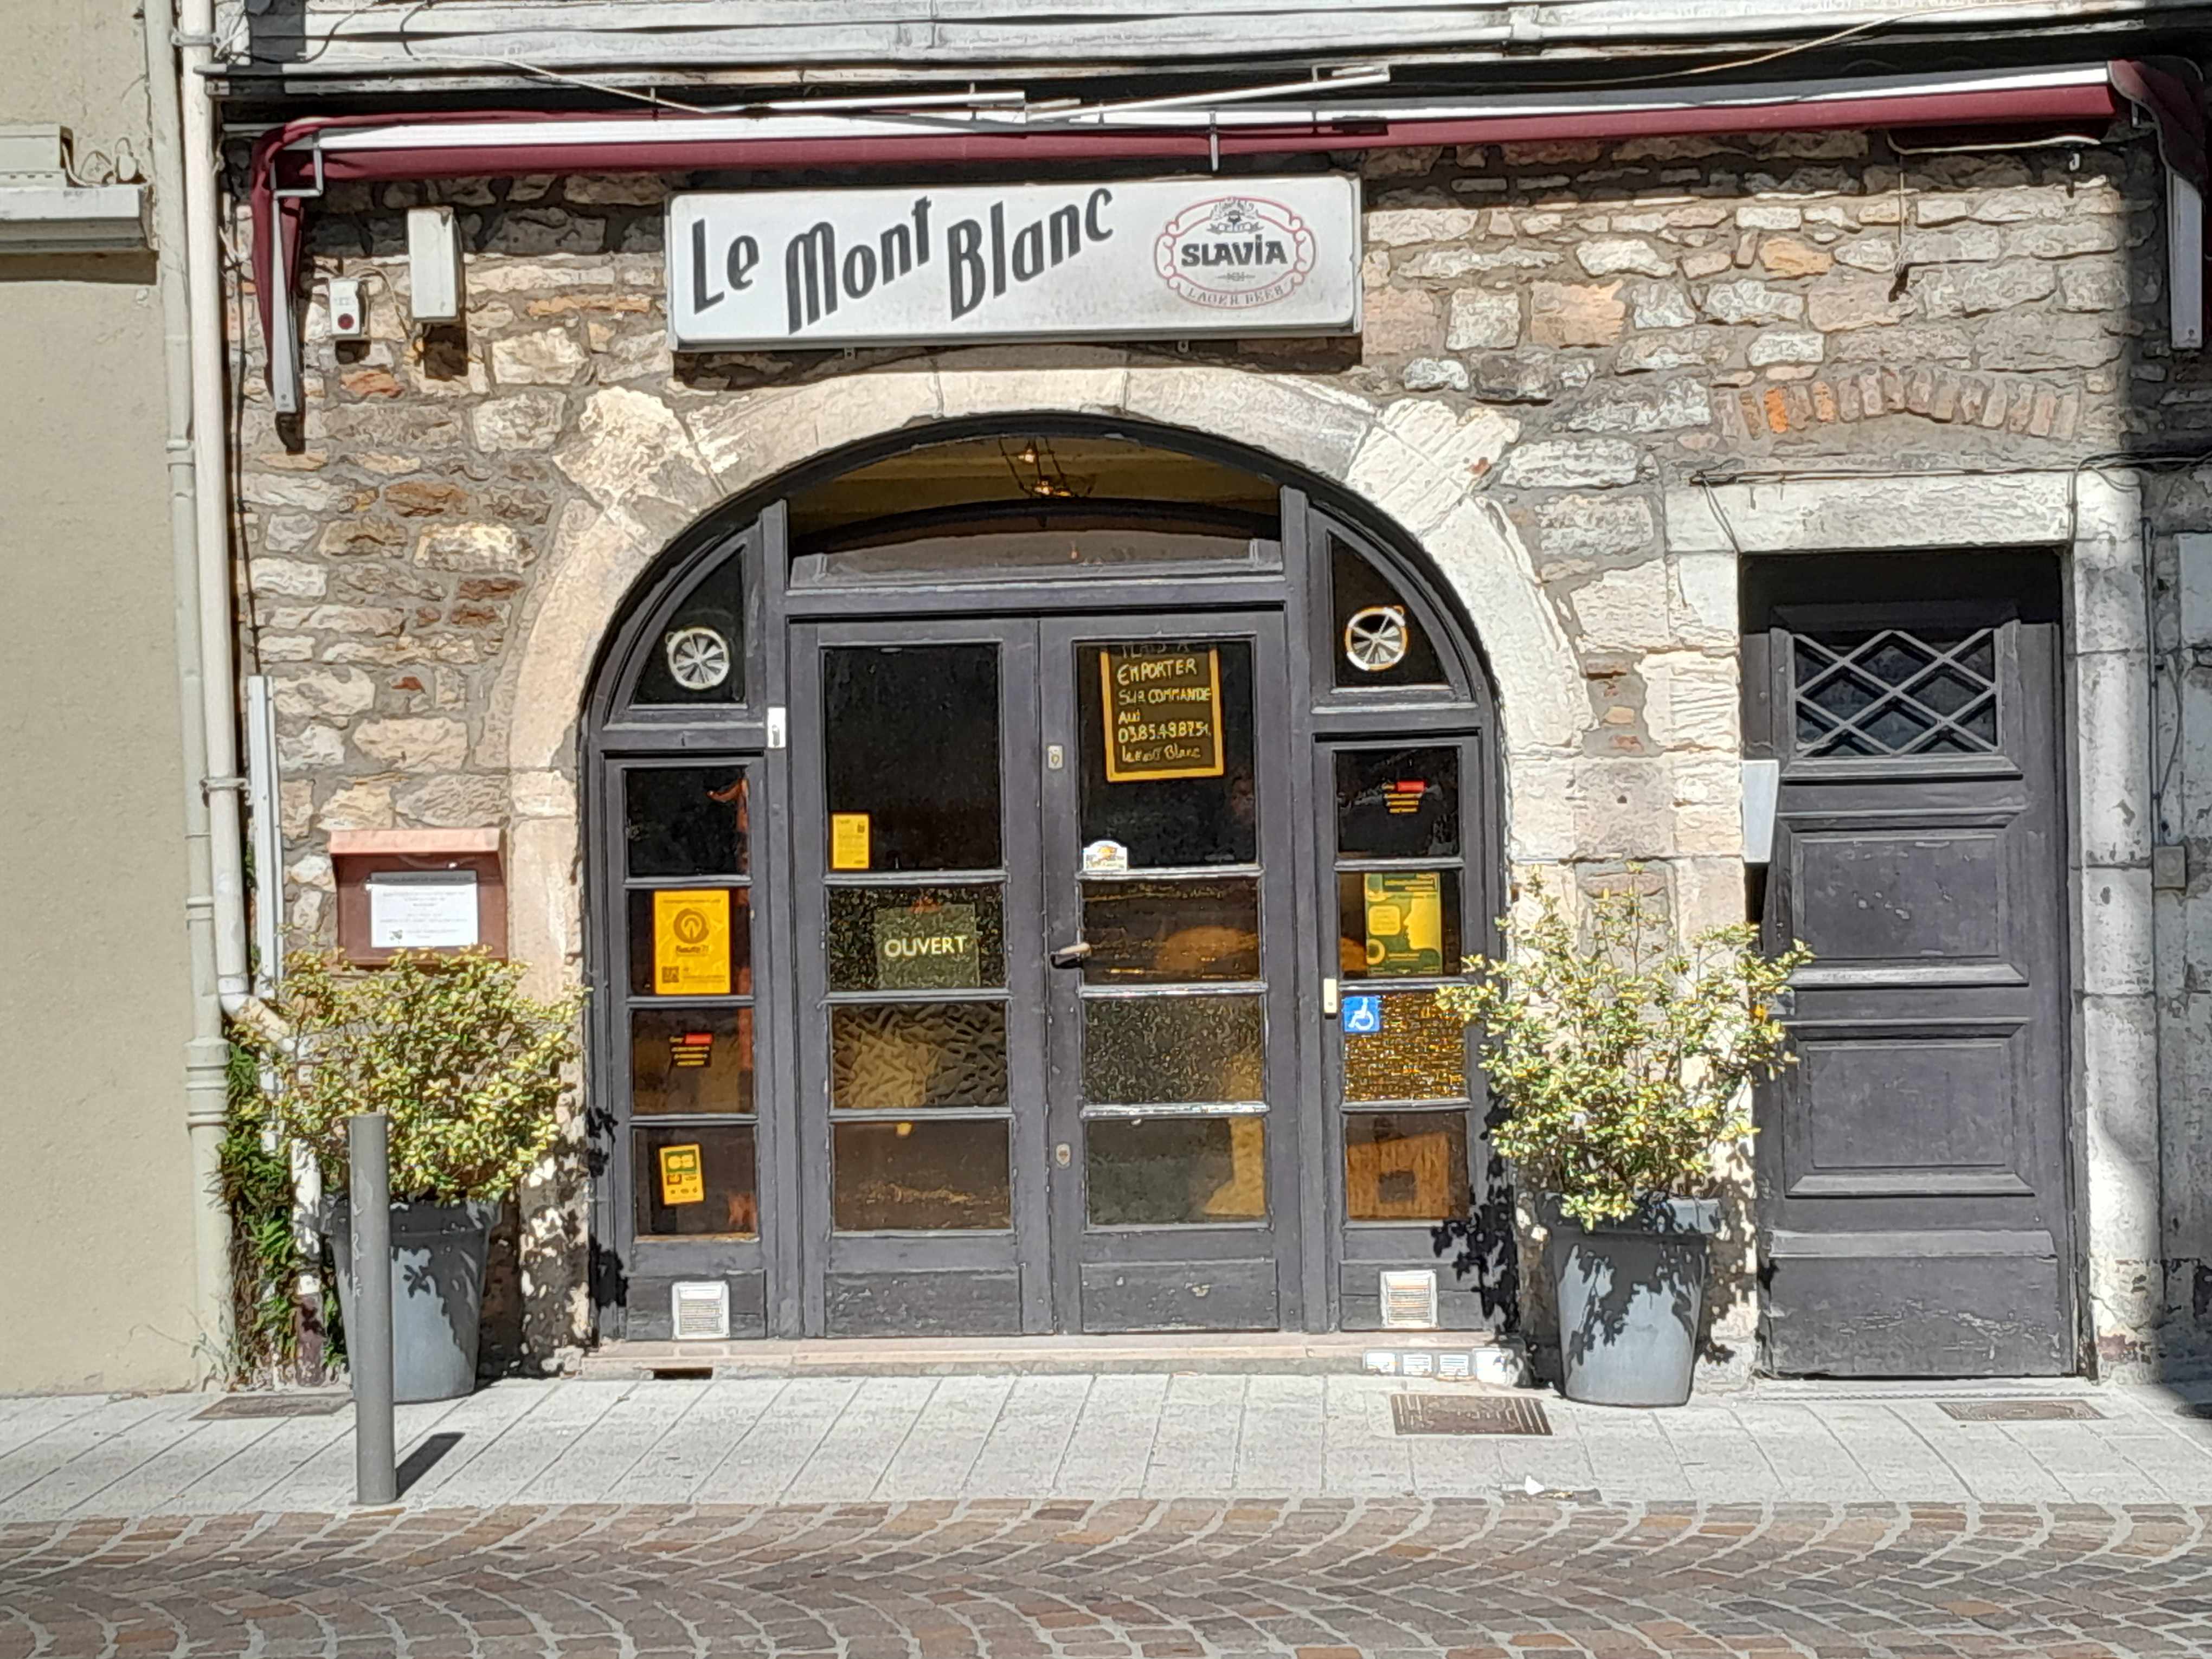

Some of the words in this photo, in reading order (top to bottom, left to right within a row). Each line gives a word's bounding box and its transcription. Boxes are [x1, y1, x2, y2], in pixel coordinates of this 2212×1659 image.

[693, 218, 759, 315] Le
[786, 196, 931, 335] Mont
[947, 188, 1113, 321] Blanc
[1117, 658, 1198, 686] EMPORTER
[884, 935, 968, 957] OUVERT
